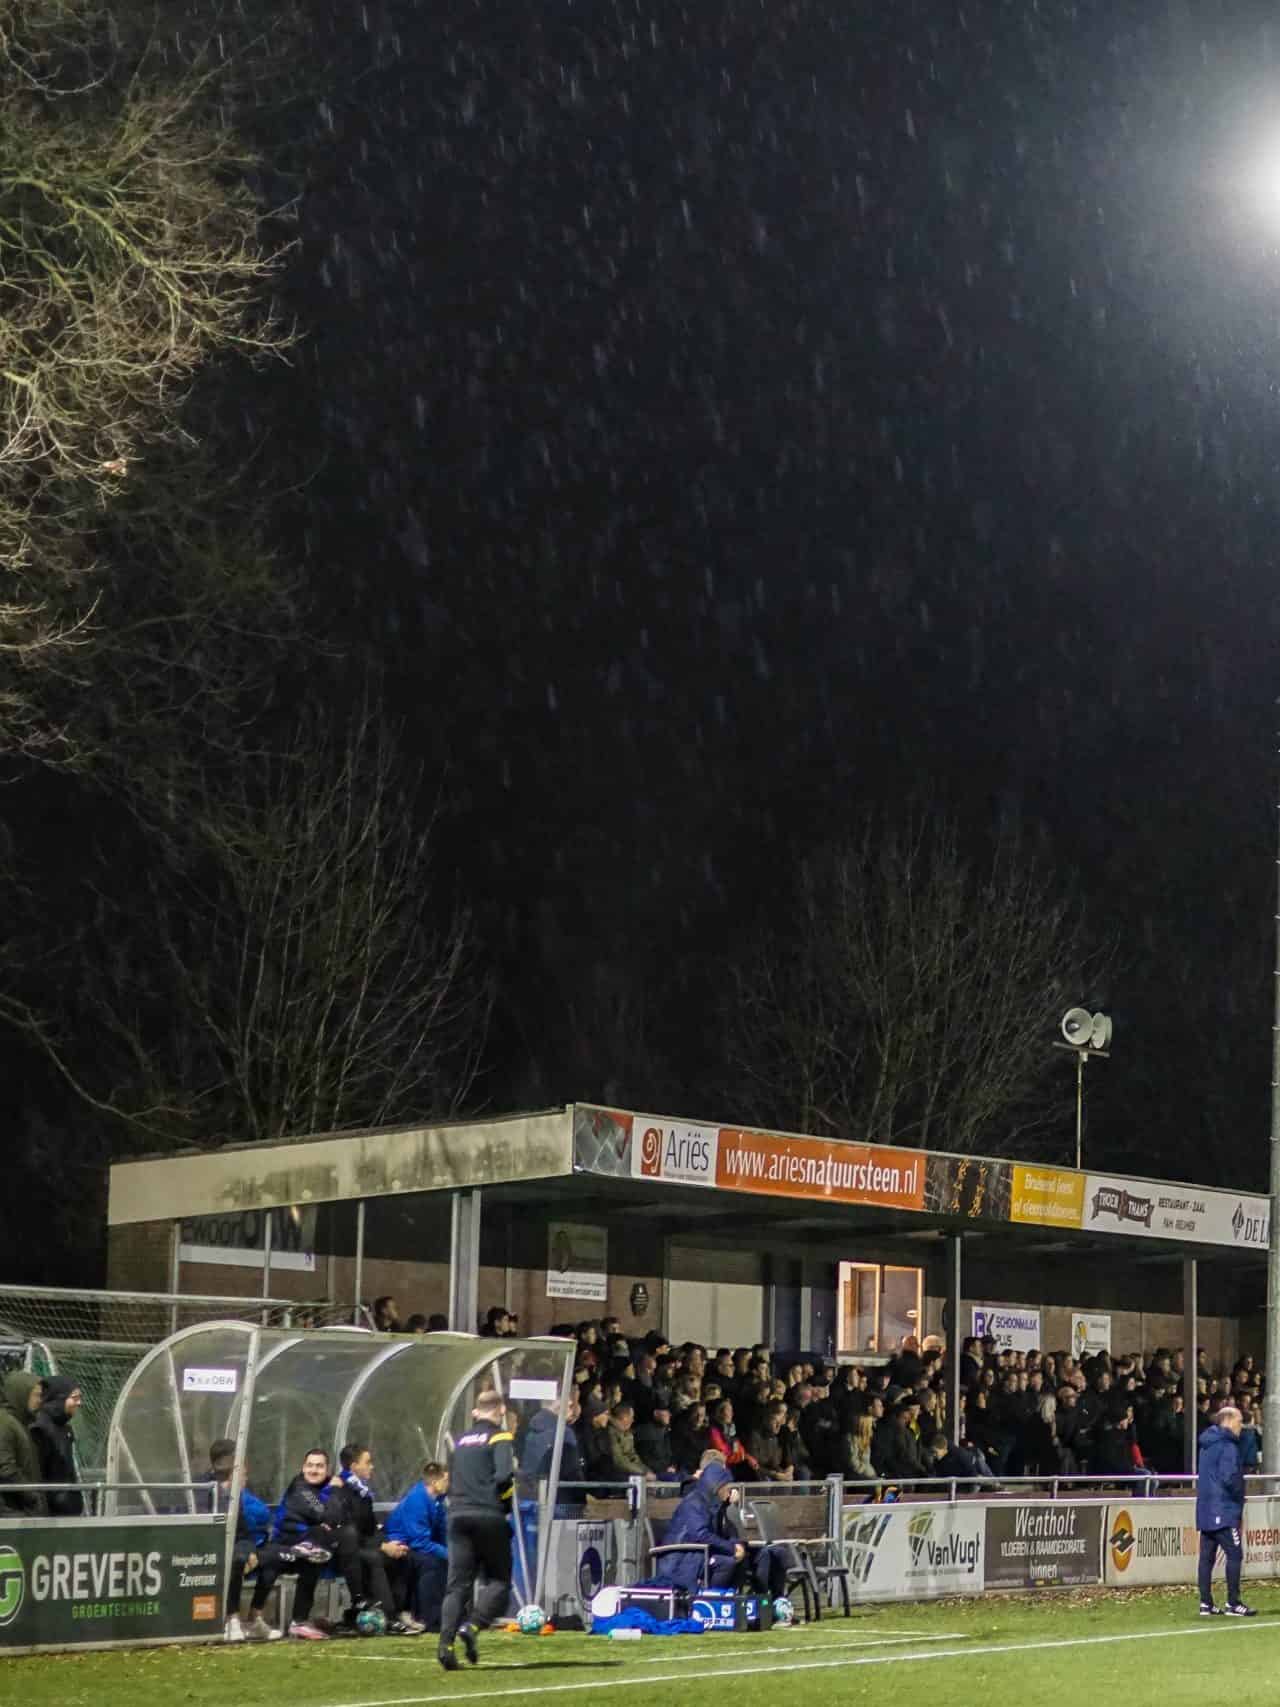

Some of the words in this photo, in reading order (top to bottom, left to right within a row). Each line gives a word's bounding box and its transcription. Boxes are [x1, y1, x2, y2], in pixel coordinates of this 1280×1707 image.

[665, 1129, 710, 1171] Ariës
[726, 1147, 918, 1195] www.ariesnatuursteen.nl
[1129, 1200, 1148, 1216] THANS
[1244, 1218, 1258, 1241] DE
[1015, 1507, 1076, 1537] Wentholt
[1137, 1527, 1181, 1557] HOORNSTRA
[32, 1551, 162, 1601] GREVERS
[72, 1602, 161, 1619] GROENTECHNIEK
